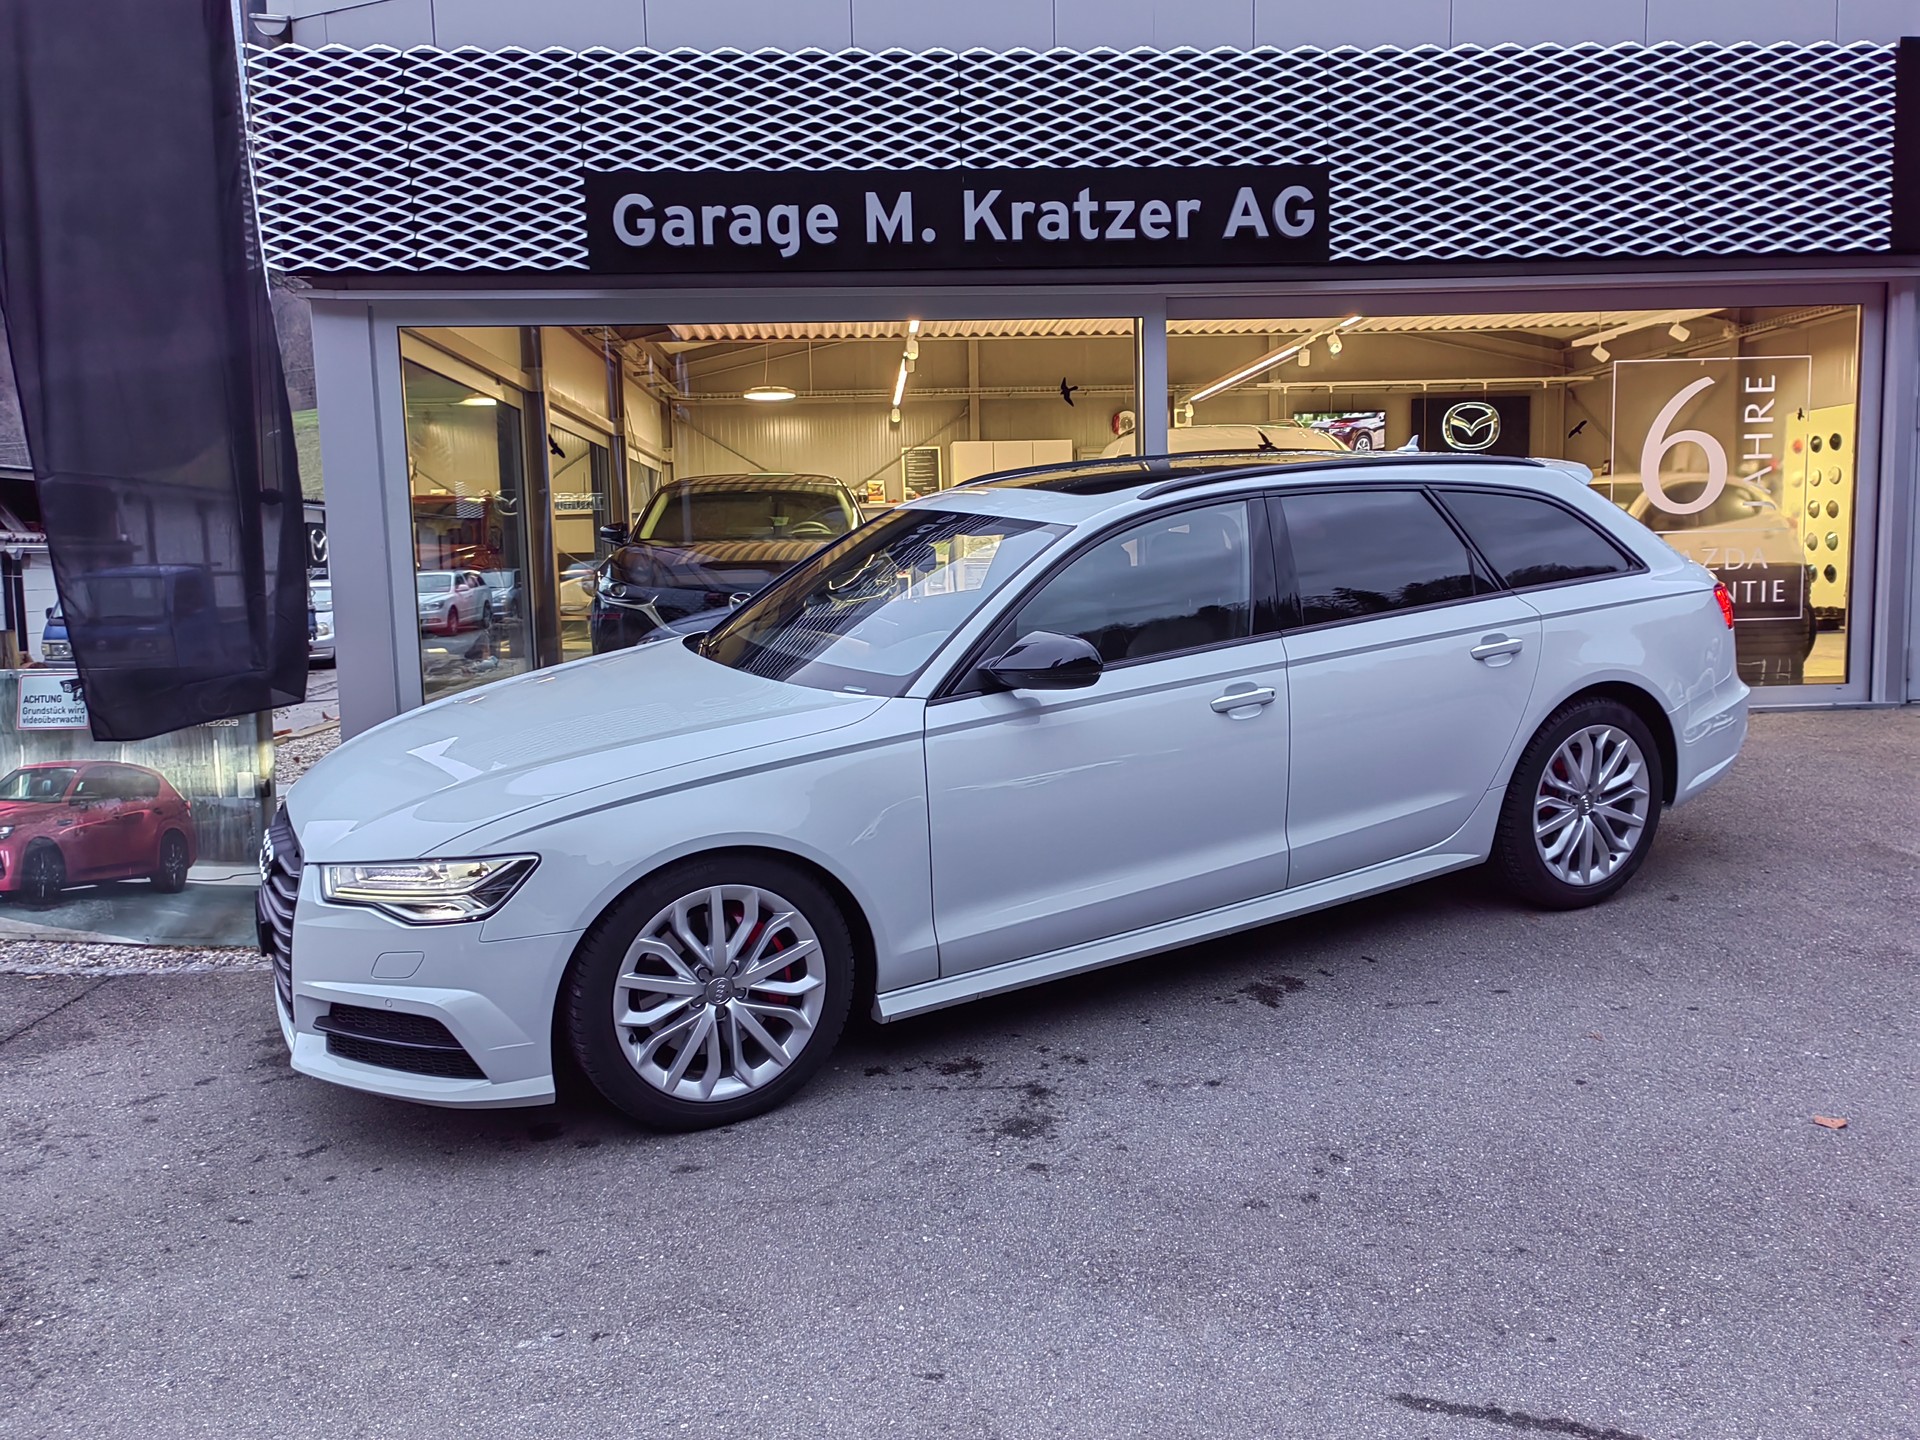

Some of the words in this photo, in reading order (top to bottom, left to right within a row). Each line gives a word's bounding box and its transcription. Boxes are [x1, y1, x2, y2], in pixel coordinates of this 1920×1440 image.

[612, 193, 839, 258] Garage
[865, 191, 936, 244] M.
[963, 187, 1201, 241] Kratzer
[1222, 185, 1315, 239] AG
[1640, 376, 1728, 515] 6
[1742, 374, 1776, 511] JAHRE
[1682, 547, 1768, 571] ZDA
[22, 706, 66, 715] Grundstück
[68, 706, 85, 714] wird
[23, 694, 62, 704] ACHTUNG
[22, 715, 85, 724] videoüberwacht!
